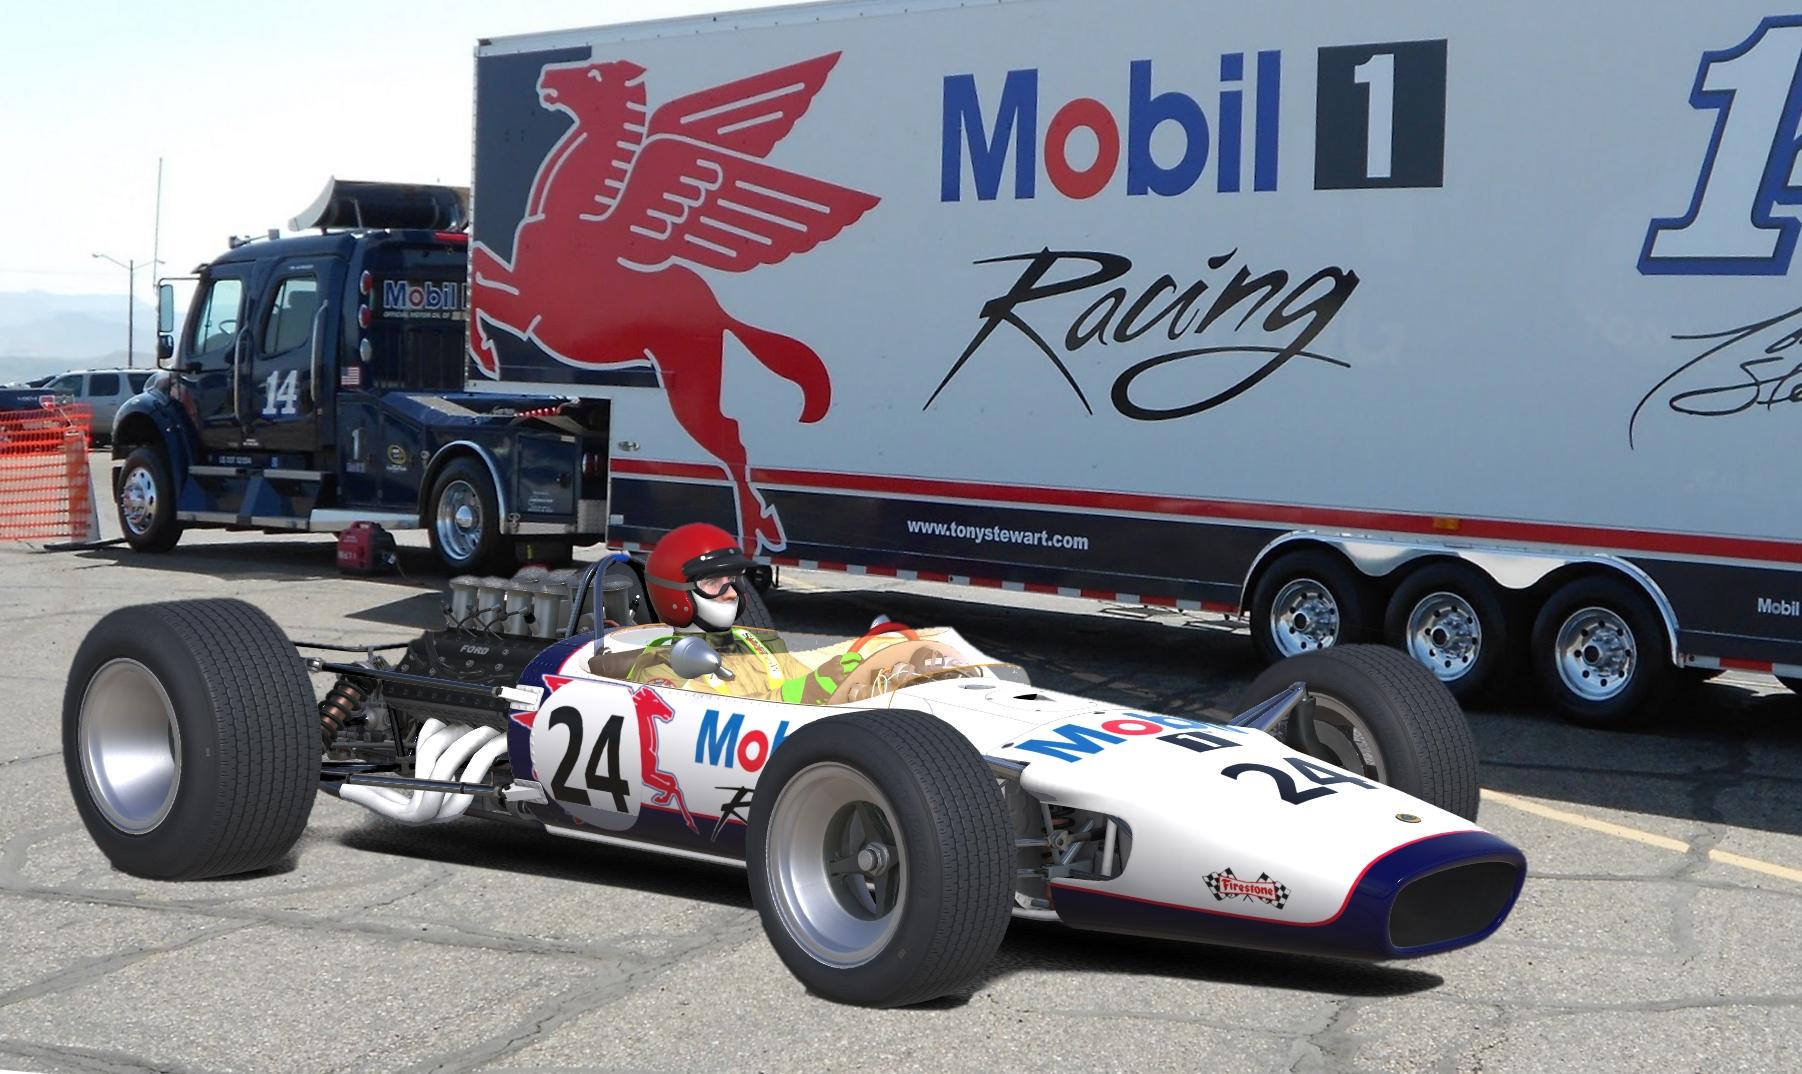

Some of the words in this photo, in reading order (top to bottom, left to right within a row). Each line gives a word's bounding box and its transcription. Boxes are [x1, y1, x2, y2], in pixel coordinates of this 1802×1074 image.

[941, 50, 1282, 203] Mobil
[1353, 53, 1396, 179] 1
[1636, 14, 1802, 276] 1
[383, 280, 458, 310] Mobil
[922, 246, 1361, 421] Racing
[261, 370, 298, 415] 14
[907, 520, 1089, 550] www.tonystewart.com
[1757, 597, 1800, 616] Mobil
[460, 644, 490, 655] FORD
[548, 705, 631, 813] 24
[1220, 757, 1379, 805] 24
[1221, 878, 1274, 896] Firestone
